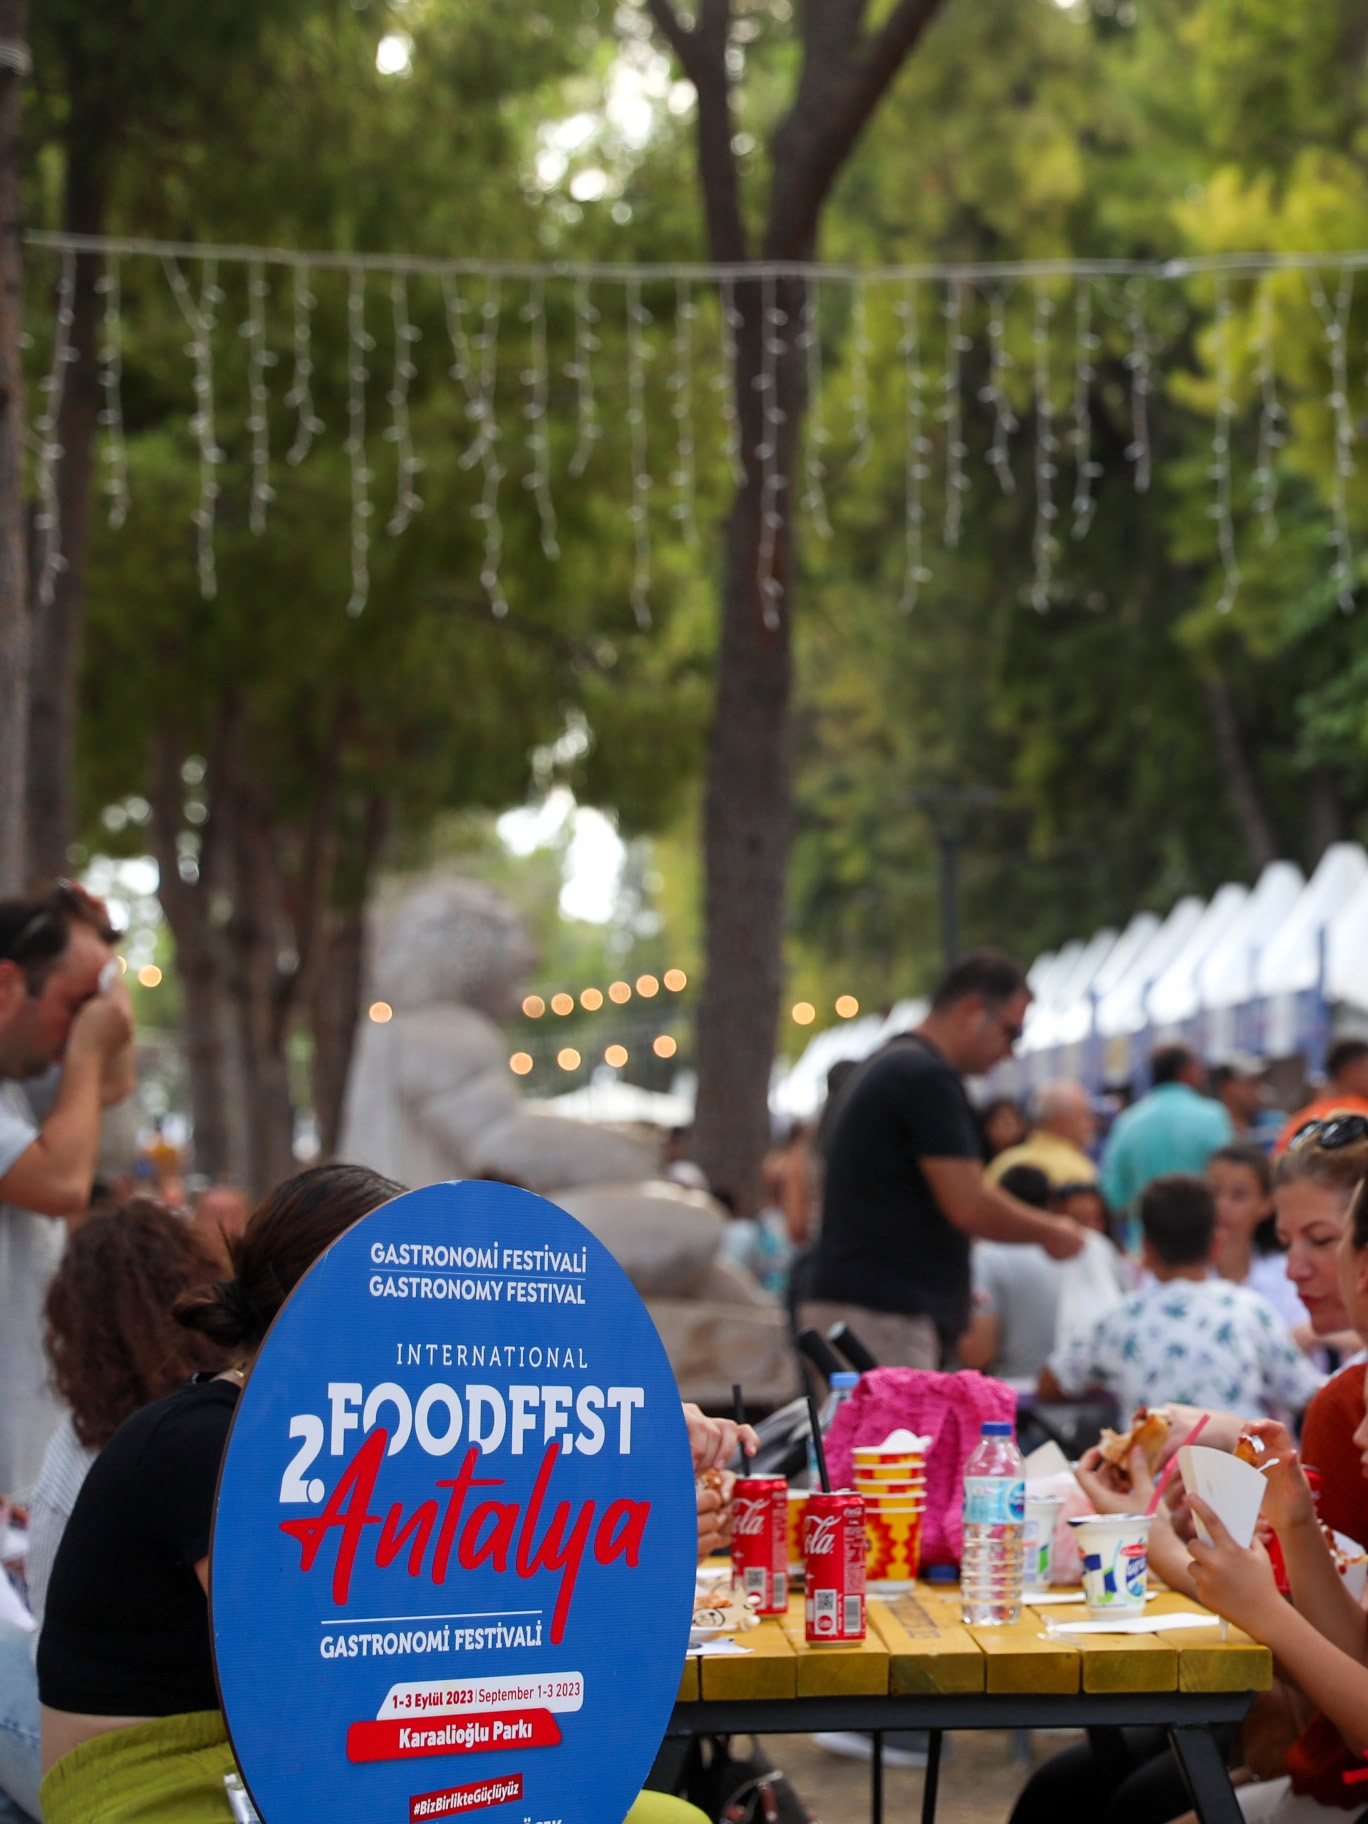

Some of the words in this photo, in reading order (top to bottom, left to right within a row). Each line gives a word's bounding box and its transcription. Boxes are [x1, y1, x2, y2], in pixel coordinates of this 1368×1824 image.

[370, 1241, 499, 1269] GASTRONOMİ
[502, 1244, 587, 1273] FESTİVALİ
[369, 1275, 503, 1301] GASTRONOMY
[506, 1281, 586, 1305] FESTIVAL
[396, 1343, 588, 1369] INTERNATIONAL
[279, 1414, 325, 1504] 2.
[327, 1382, 645, 1457] FOODFEST
[279, 1427, 651, 1645] Antalya
[320, 1625, 450, 1658] GASTRONOMİ
[454, 1620, 542, 1650] FESTİVALİ
[392, 1693, 412, 1709] 1-3
[414, 1691, 444, 1711] Eylül
[446, 1689, 474, 1705] 2023
[478, 1686, 535, 1706] September
[537, 1683, 554, 1699] 1-3
[556, 1682, 581, 1698] 2023
[398, 1722, 490, 1749] Karaalioğlu
[492, 1718, 532, 1741] Parkı
[413, 1780, 520, 1816] #BizBirlikteGüçlüyüz
